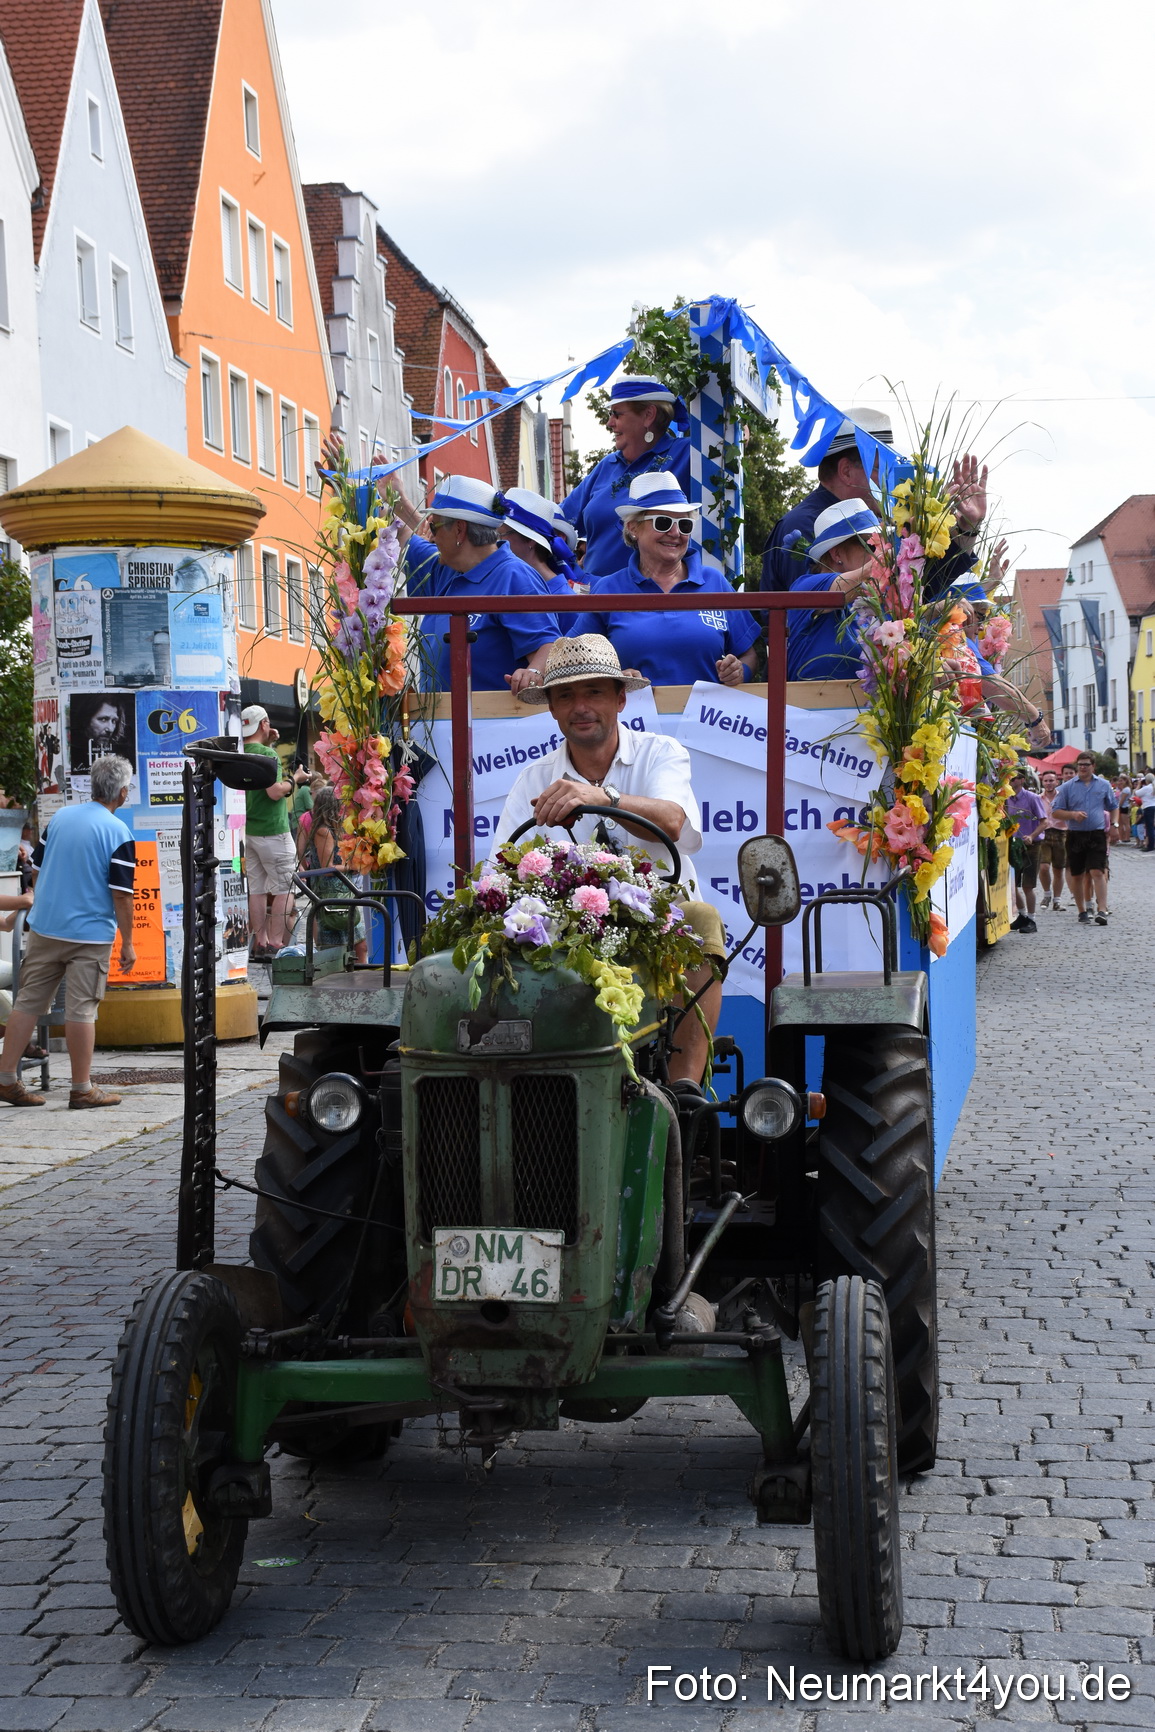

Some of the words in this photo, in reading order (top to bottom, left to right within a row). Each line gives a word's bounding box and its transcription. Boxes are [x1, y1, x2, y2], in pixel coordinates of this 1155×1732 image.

[128, 562, 174, 576] CHRISTIAN
[128, 576, 171, 589] SPRINGER
[147, 708, 198, 735] G6
[699, 705, 874, 779] Weibefasching
[148, 761, 182, 769] Hoffest
[783, 799, 822, 831] ch
[159, 841, 175, 849] TIM
[133, 903, 155, 911] 016
[474, 1233, 524, 1264] NM
[441, 1266, 482, 1296] DR
[511, 1267, 550, 1298] 46
